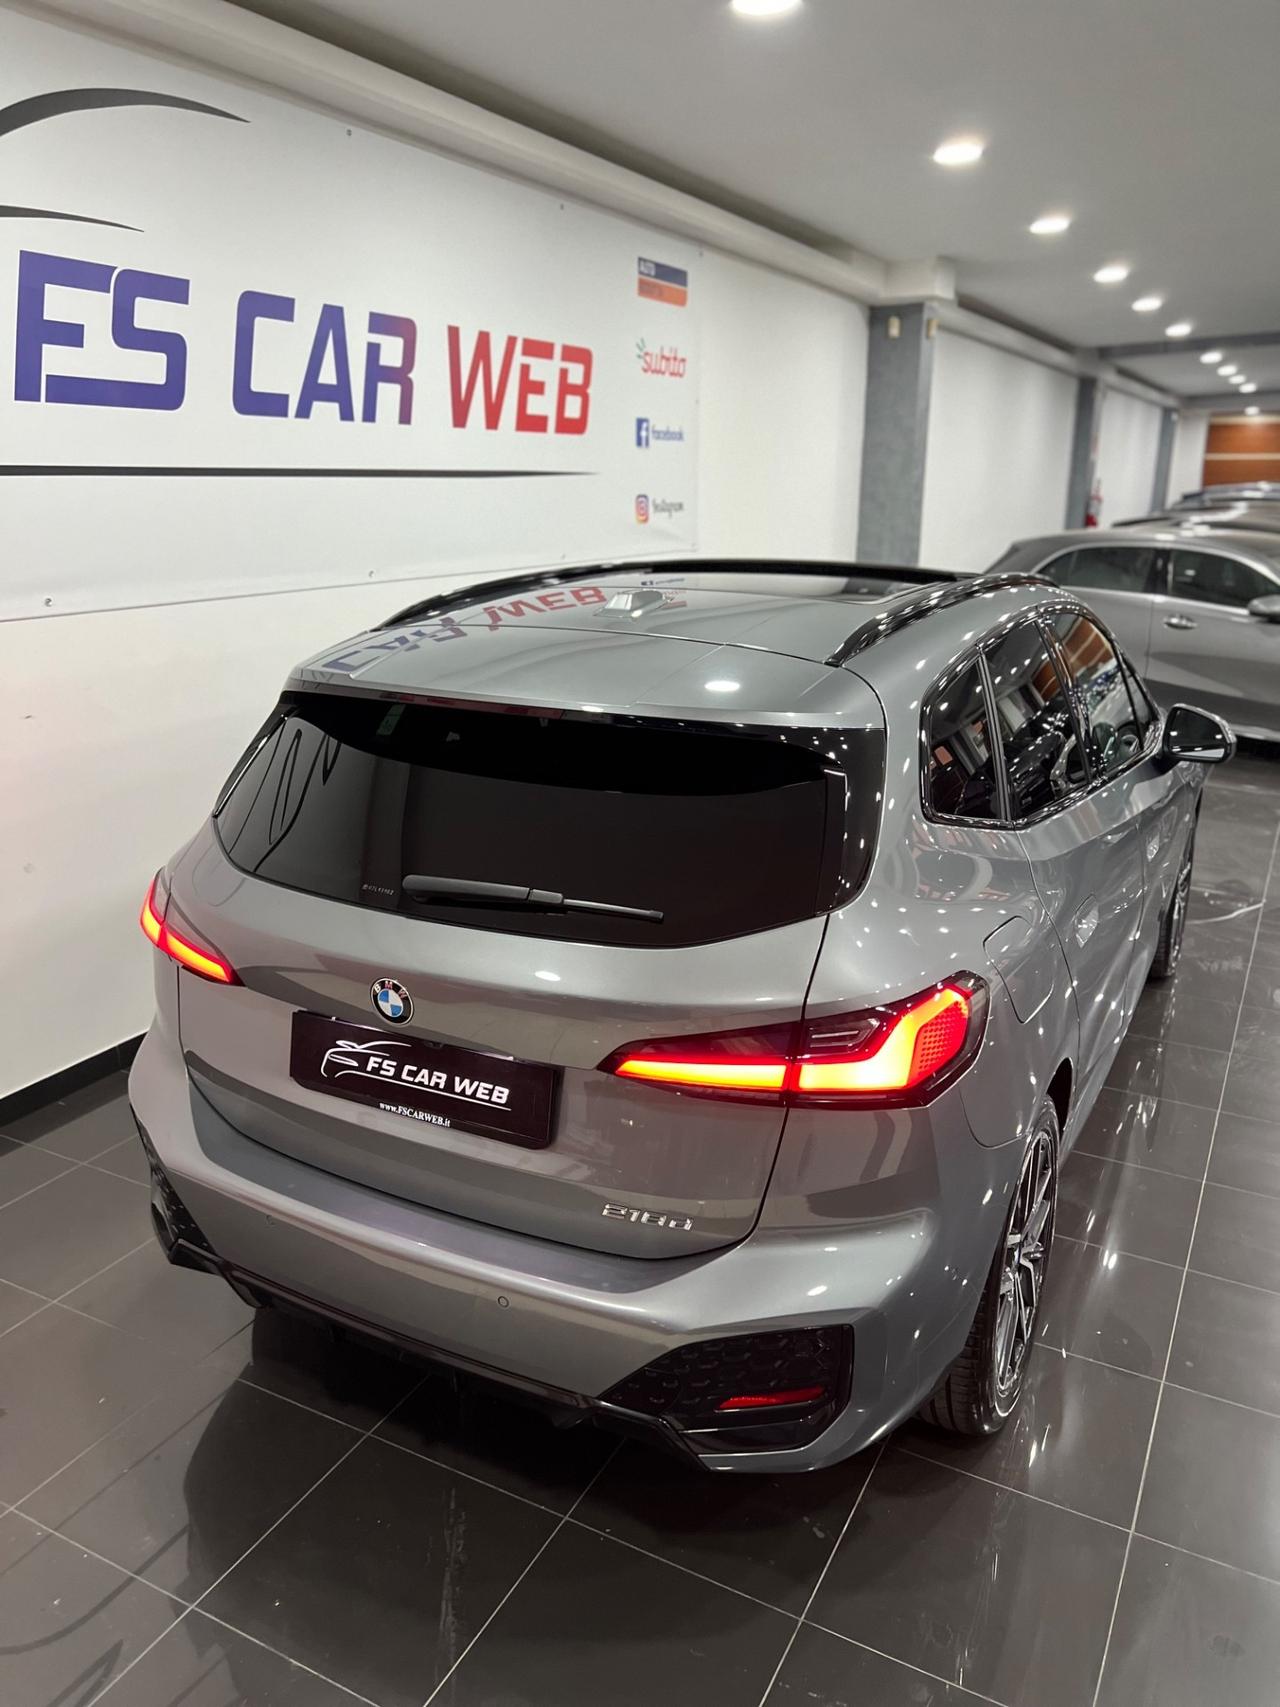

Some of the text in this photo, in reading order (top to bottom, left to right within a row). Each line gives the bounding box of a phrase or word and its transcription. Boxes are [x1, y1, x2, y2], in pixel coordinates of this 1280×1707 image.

[14, 250, 594, 435] FS CAR WEB
[641, 347, 687, 378] subito
[366, 1057, 510, 1104] FS CAR WEB
[379, 1102, 451, 1127] www.FSCARWEB.it
[602, 1203, 693, 1231] 218d
